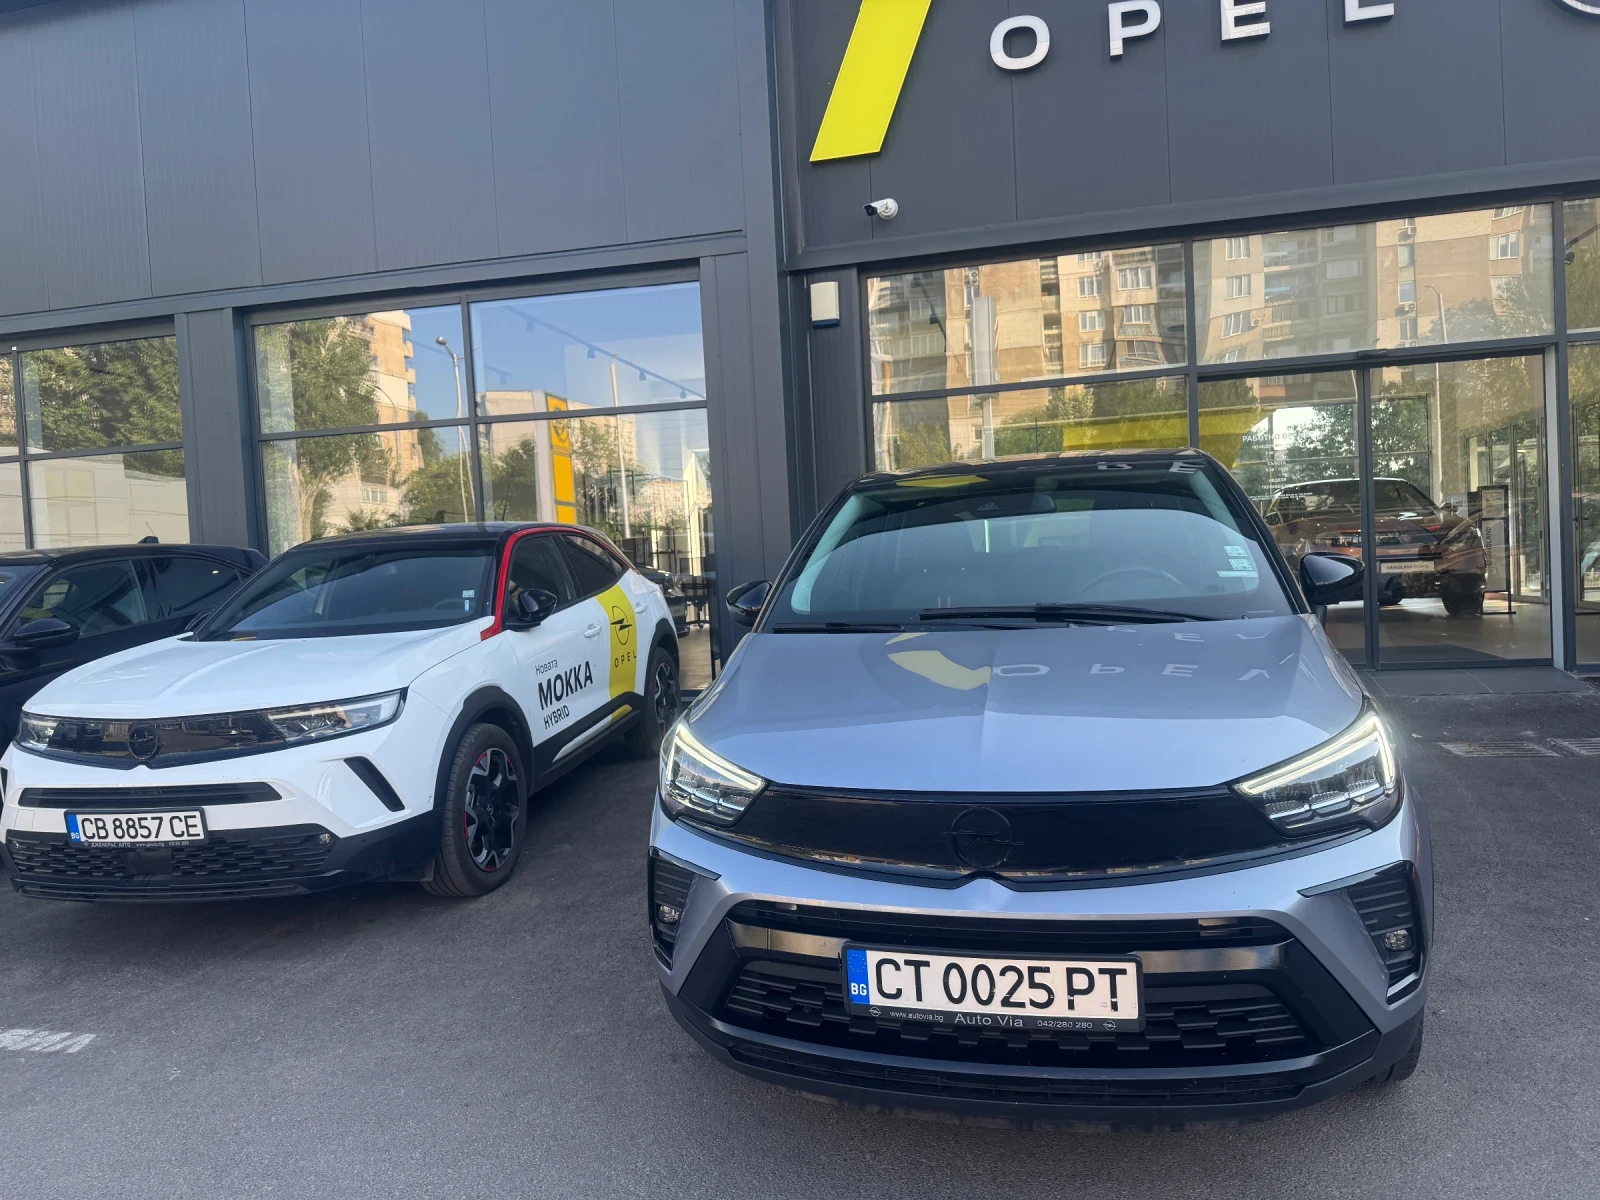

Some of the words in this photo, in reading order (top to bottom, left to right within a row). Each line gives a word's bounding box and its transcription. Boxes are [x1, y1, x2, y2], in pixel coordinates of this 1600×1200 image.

[534, 659, 559, 676] Новата
[614, 650, 637, 668] OPEL
[537, 660, 594, 711] MOKKA
[542, 704, 570, 730] HYBRID
[70, 832, 80, 840] BG
[81, 817, 109, 840] CB
[112, 816, 164, 840] 8857
[169, 815, 201, 838] CE
[850, 982, 868, 997] BG
[875, 957, 931, 1002] CT
[942, 962, 1055, 1010] 0025
[1066, 966, 1128, 1012] PT
[889, 1010, 944, 1023] www.autovia.bg
[953, 1012, 992, 1027] Auto
[996, 1014, 1024, 1028] Via
[1036, 1019, 1073, 1029] 042/280
[1075, 1021, 1093, 1030] 280
